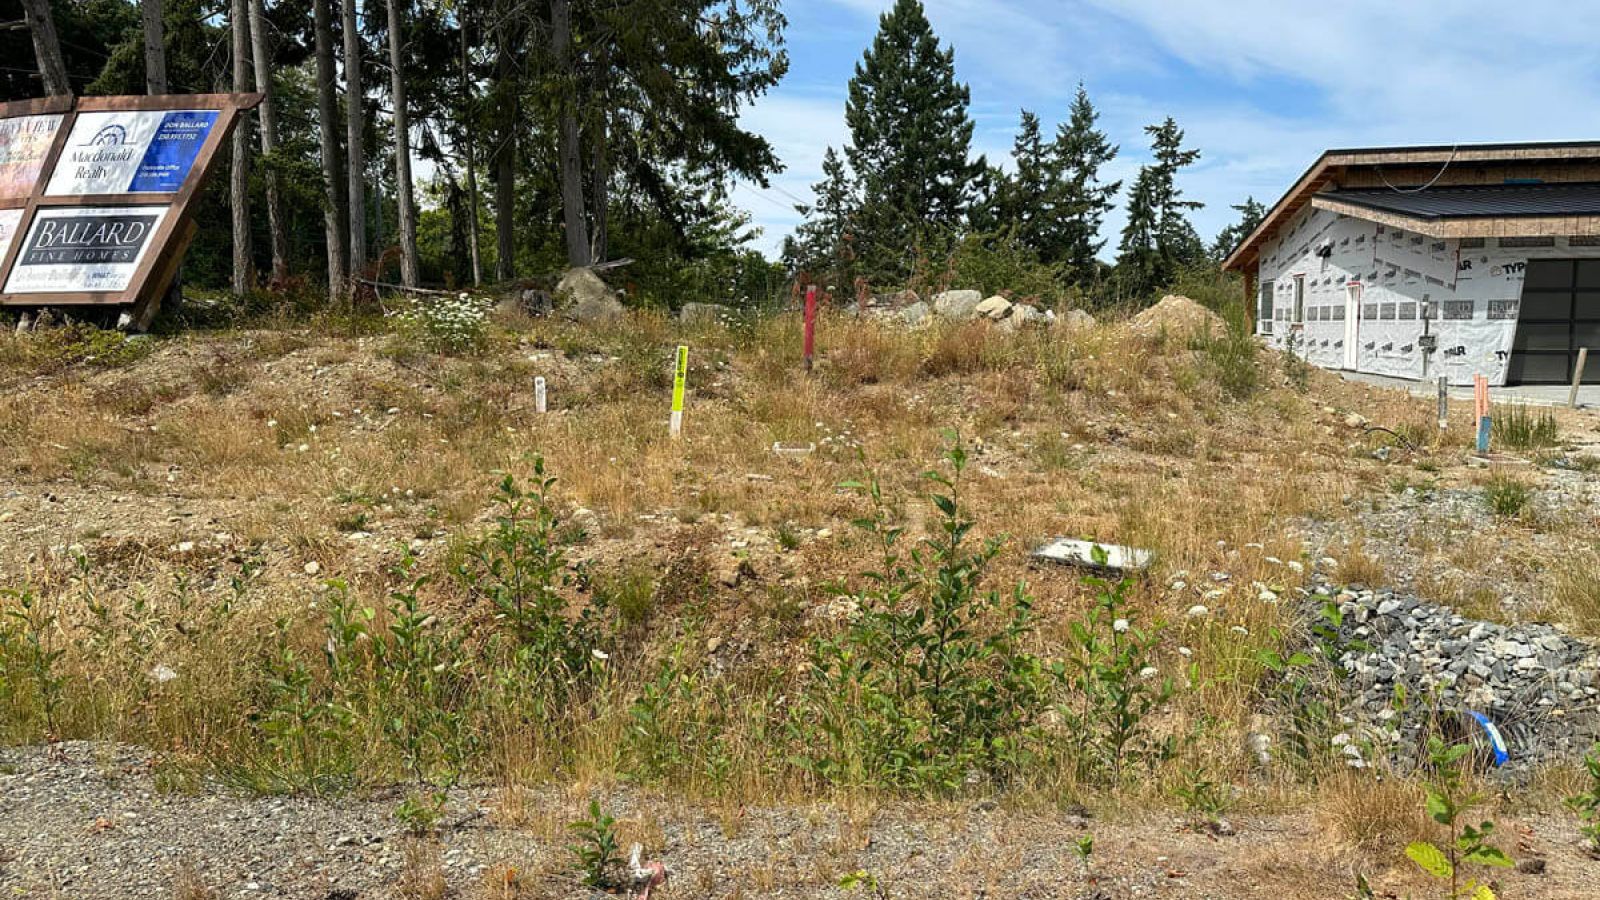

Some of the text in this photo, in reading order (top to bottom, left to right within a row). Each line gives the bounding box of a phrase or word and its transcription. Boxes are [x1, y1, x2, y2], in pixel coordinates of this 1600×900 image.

[71, 148, 134, 162] Macdonald
[75, 165, 106, 179] Realty
[36, 221, 145, 247] BALLARD
[30, 250, 130, 262] FINE HOMES
